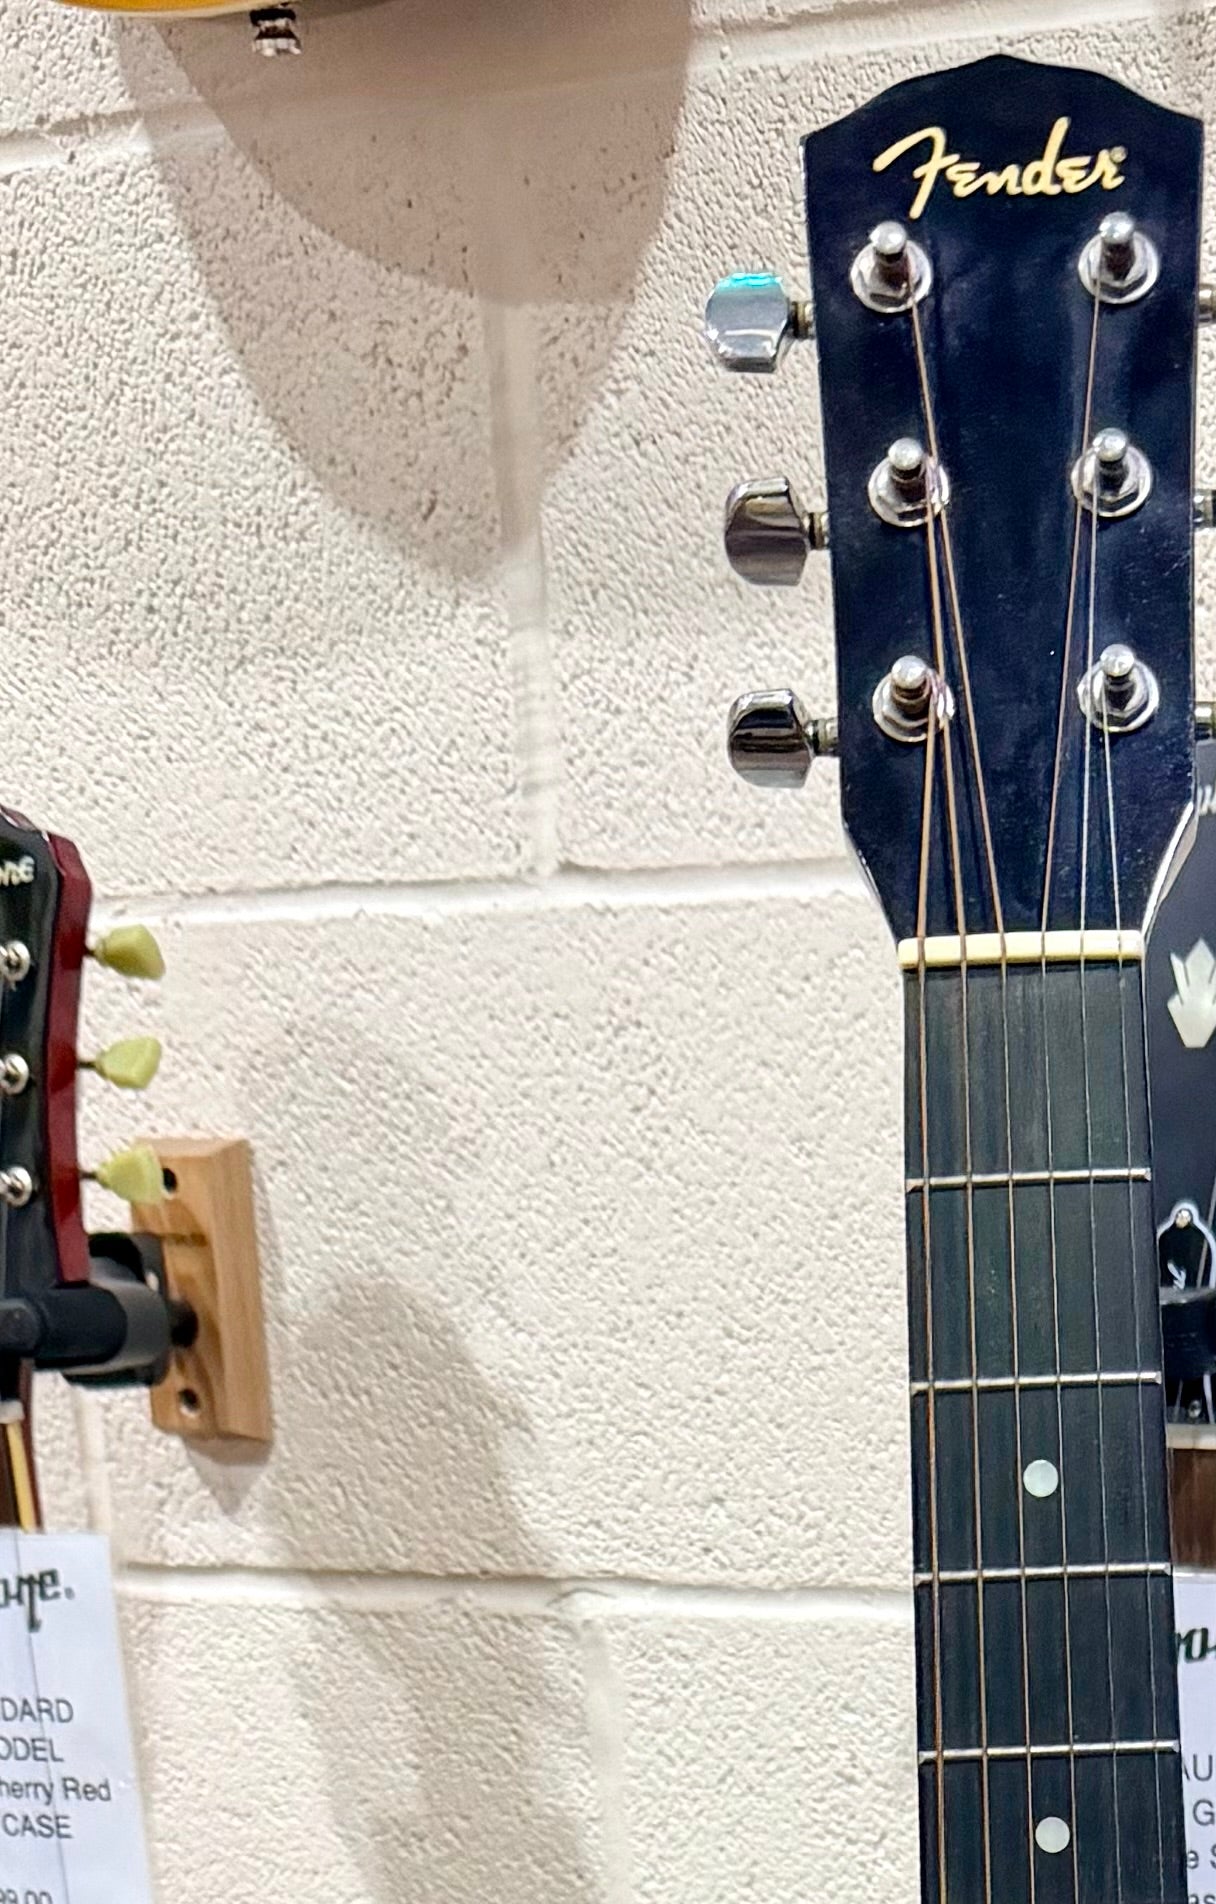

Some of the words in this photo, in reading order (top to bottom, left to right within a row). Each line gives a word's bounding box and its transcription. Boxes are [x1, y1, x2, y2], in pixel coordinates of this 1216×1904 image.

[872, 116, 1126, 220] Fender
[62, 1777, 112, 1802] Red
[2, 1814, 74, 1839] CASE
